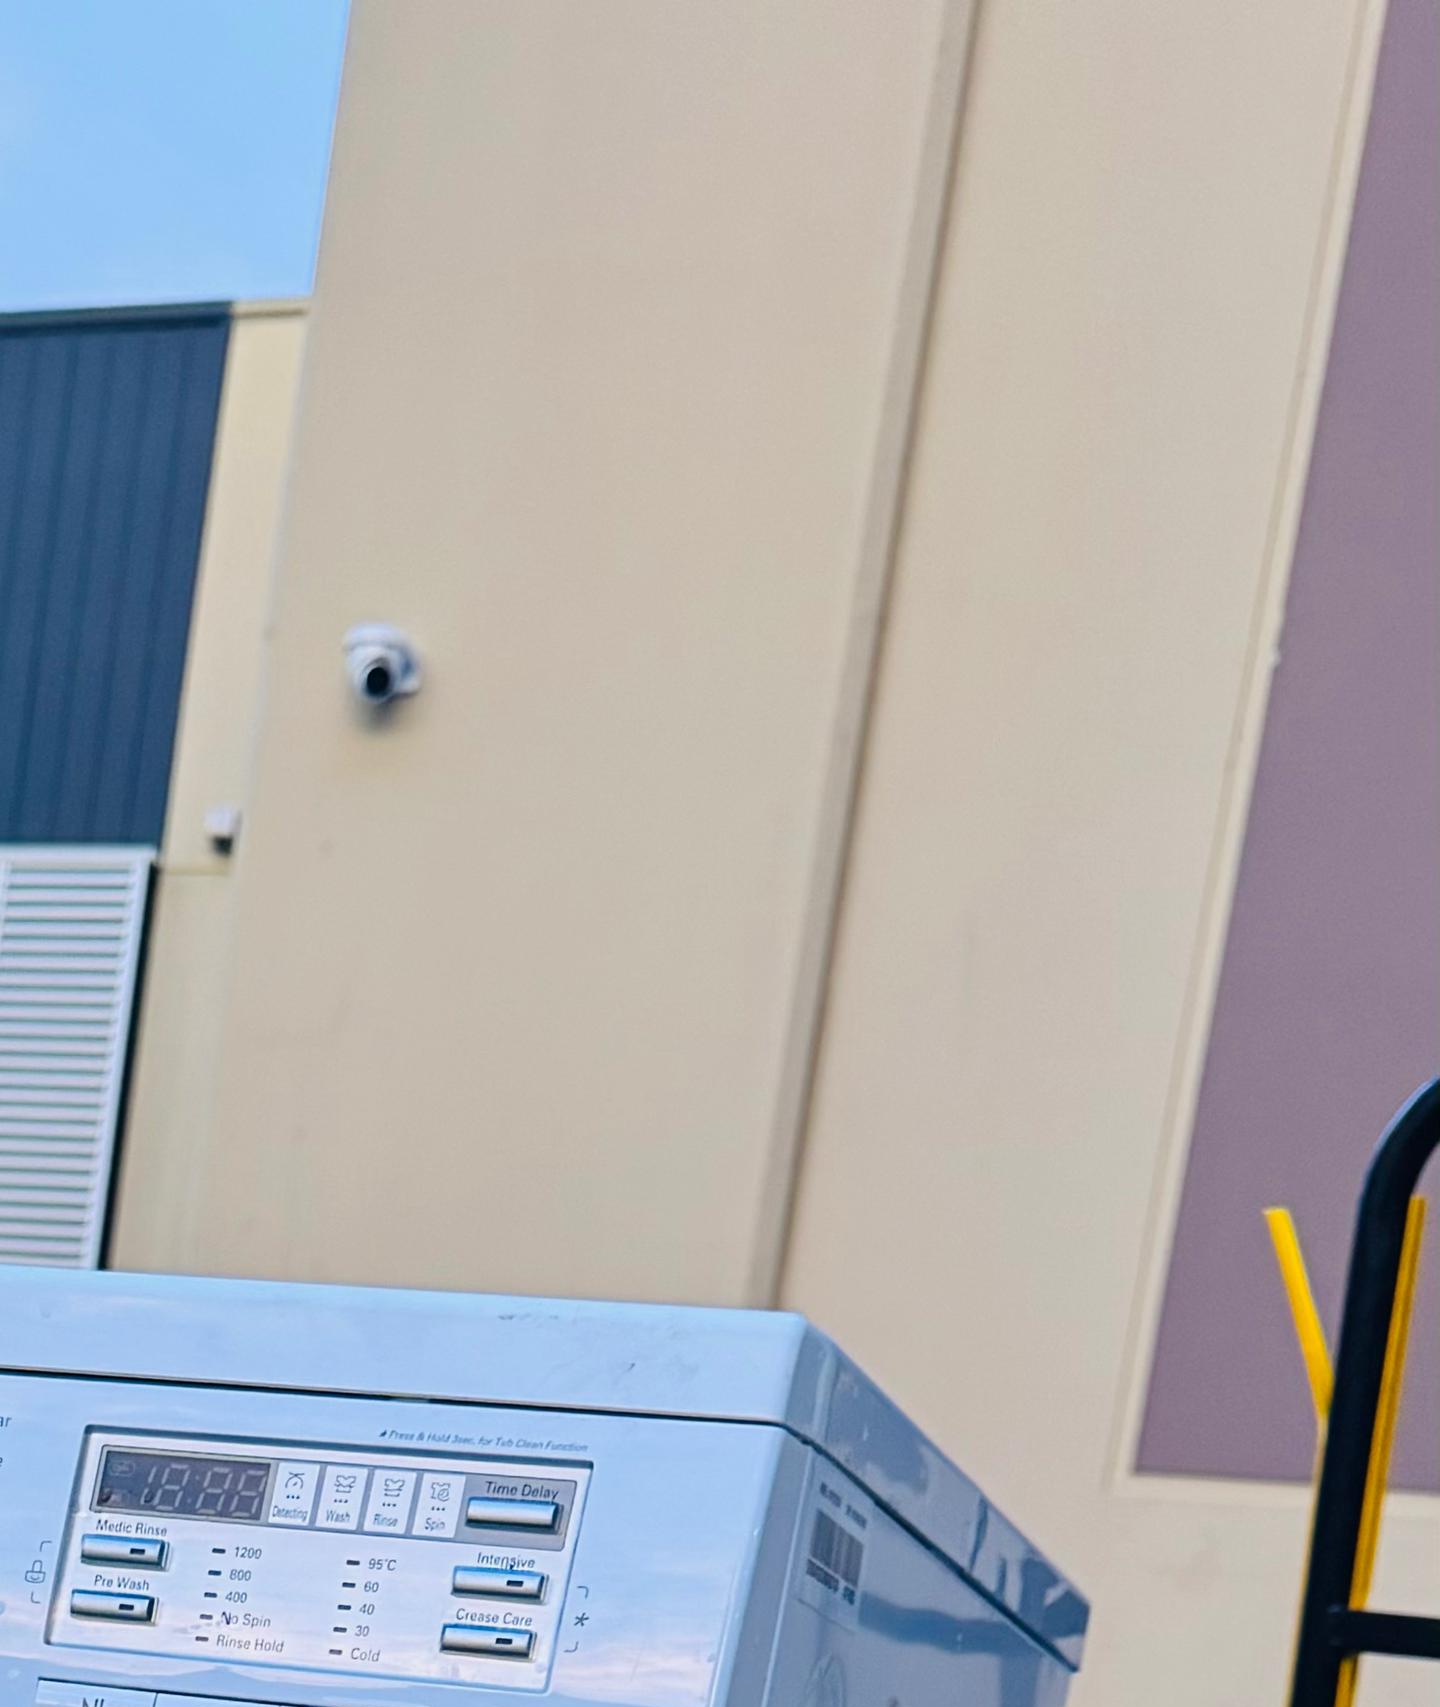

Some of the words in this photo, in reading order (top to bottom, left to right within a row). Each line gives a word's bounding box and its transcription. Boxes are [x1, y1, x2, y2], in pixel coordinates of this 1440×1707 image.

[485, 1481, 517, 1496] Time
[520, 1483, 559, 1501] Delay
[272, 1505, 308, 1522] Detecting
[325, 1508, 351, 1523] Wash
[372, 1513, 399, 1528] Rinse
[95, 1518, 133, 1535] Medic
[135, 1521, 168, 1537] Rinse
[424, 1517, 446, 1532] Spin
[234, 1546, 263, 1560] 1200
[477, 1551, 536, 1569] Intensive
[93, 1574, 113, 1588] Pre
[117, 1577, 150, 1592] Wash
[229, 1569, 252, 1582] 800
[363, 1580, 380, 1593] 60
[225, 1591, 248, 1604] 400
[359, 1603, 375, 1616] 40
[456, 1607, 500, 1624] Crease
[503, 1611, 534, 1627] Care
[220, 1610, 239, 1626] No
[242, 1613, 271, 1629] Spin
[354, 1626, 370, 1638] 30
[216, 1634, 251, 1650] Rinse
[254, 1637, 285, 1654] Hold
[350, 1647, 381, 1662] Cold
